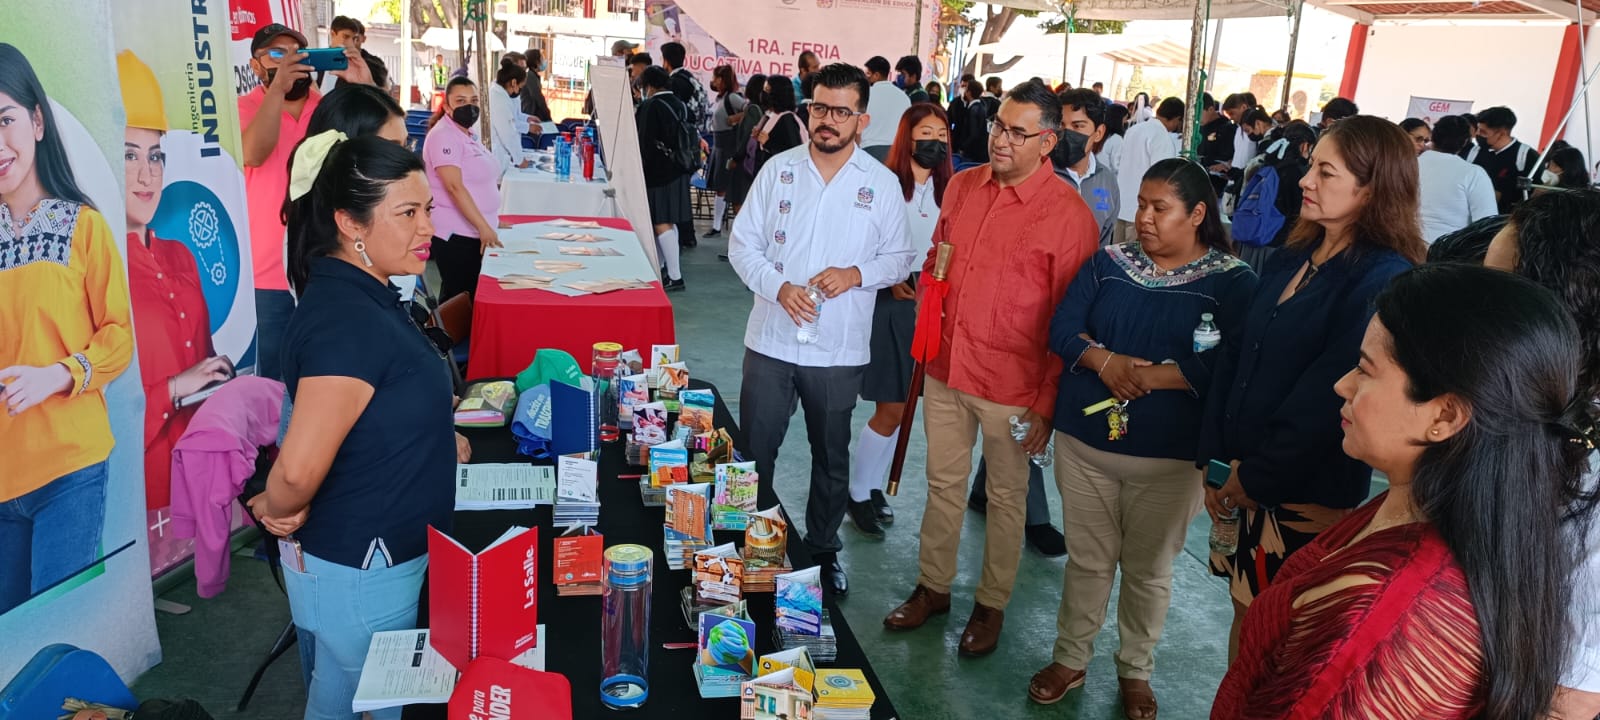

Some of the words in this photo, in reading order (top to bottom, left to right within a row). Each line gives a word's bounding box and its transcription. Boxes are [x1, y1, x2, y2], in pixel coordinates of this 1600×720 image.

[748, 38, 785, 55] 1RA.
[791, 41, 841, 60] FERIA
[770, 62, 793, 77] DE
[1429, 101, 1450, 112] GEM
[524, 587, 534, 609] La
[473, 689, 489, 716] para
